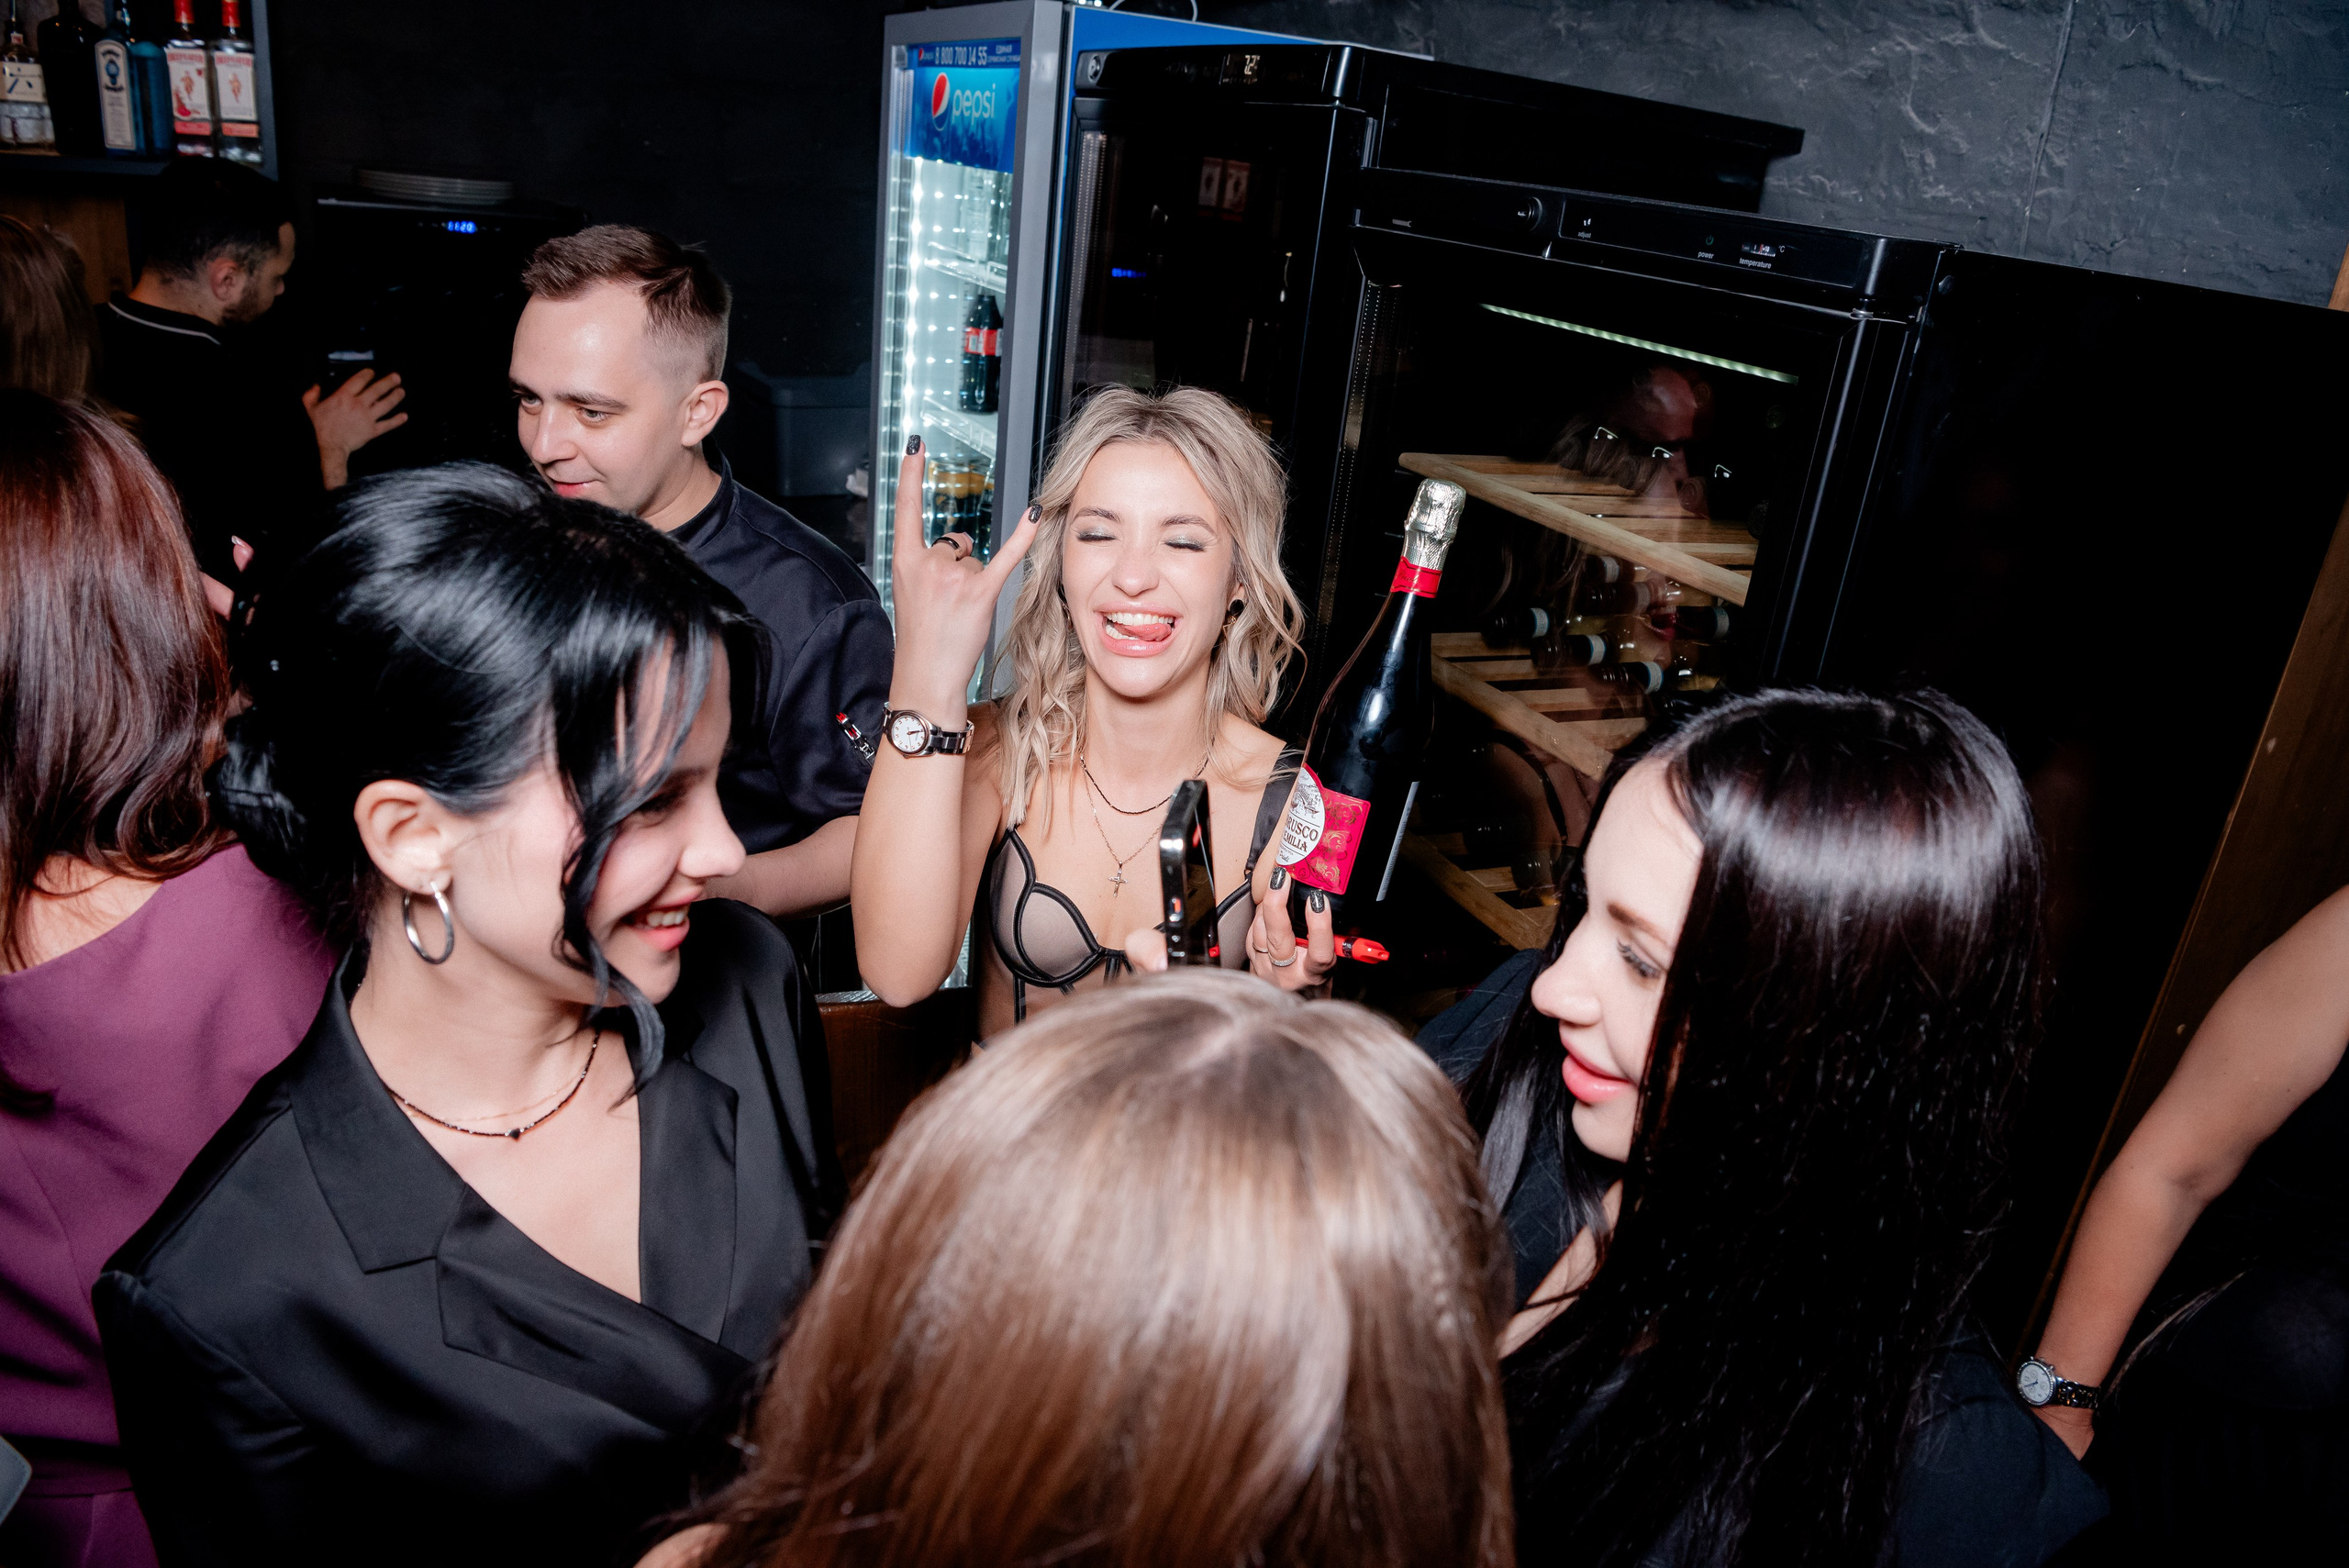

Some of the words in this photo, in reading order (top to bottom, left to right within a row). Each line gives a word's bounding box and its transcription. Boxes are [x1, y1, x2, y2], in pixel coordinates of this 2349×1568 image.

[954, 46, 967, 65] 700
[968, 46, 976, 66] 14
[977, 46, 988, 66] 55
[952, 83, 996, 125] pepsi
[1698, 250, 1715, 260] power
[1739, 257, 1772, 270] temperature
[1283, 830, 1308, 853] EMILIA
